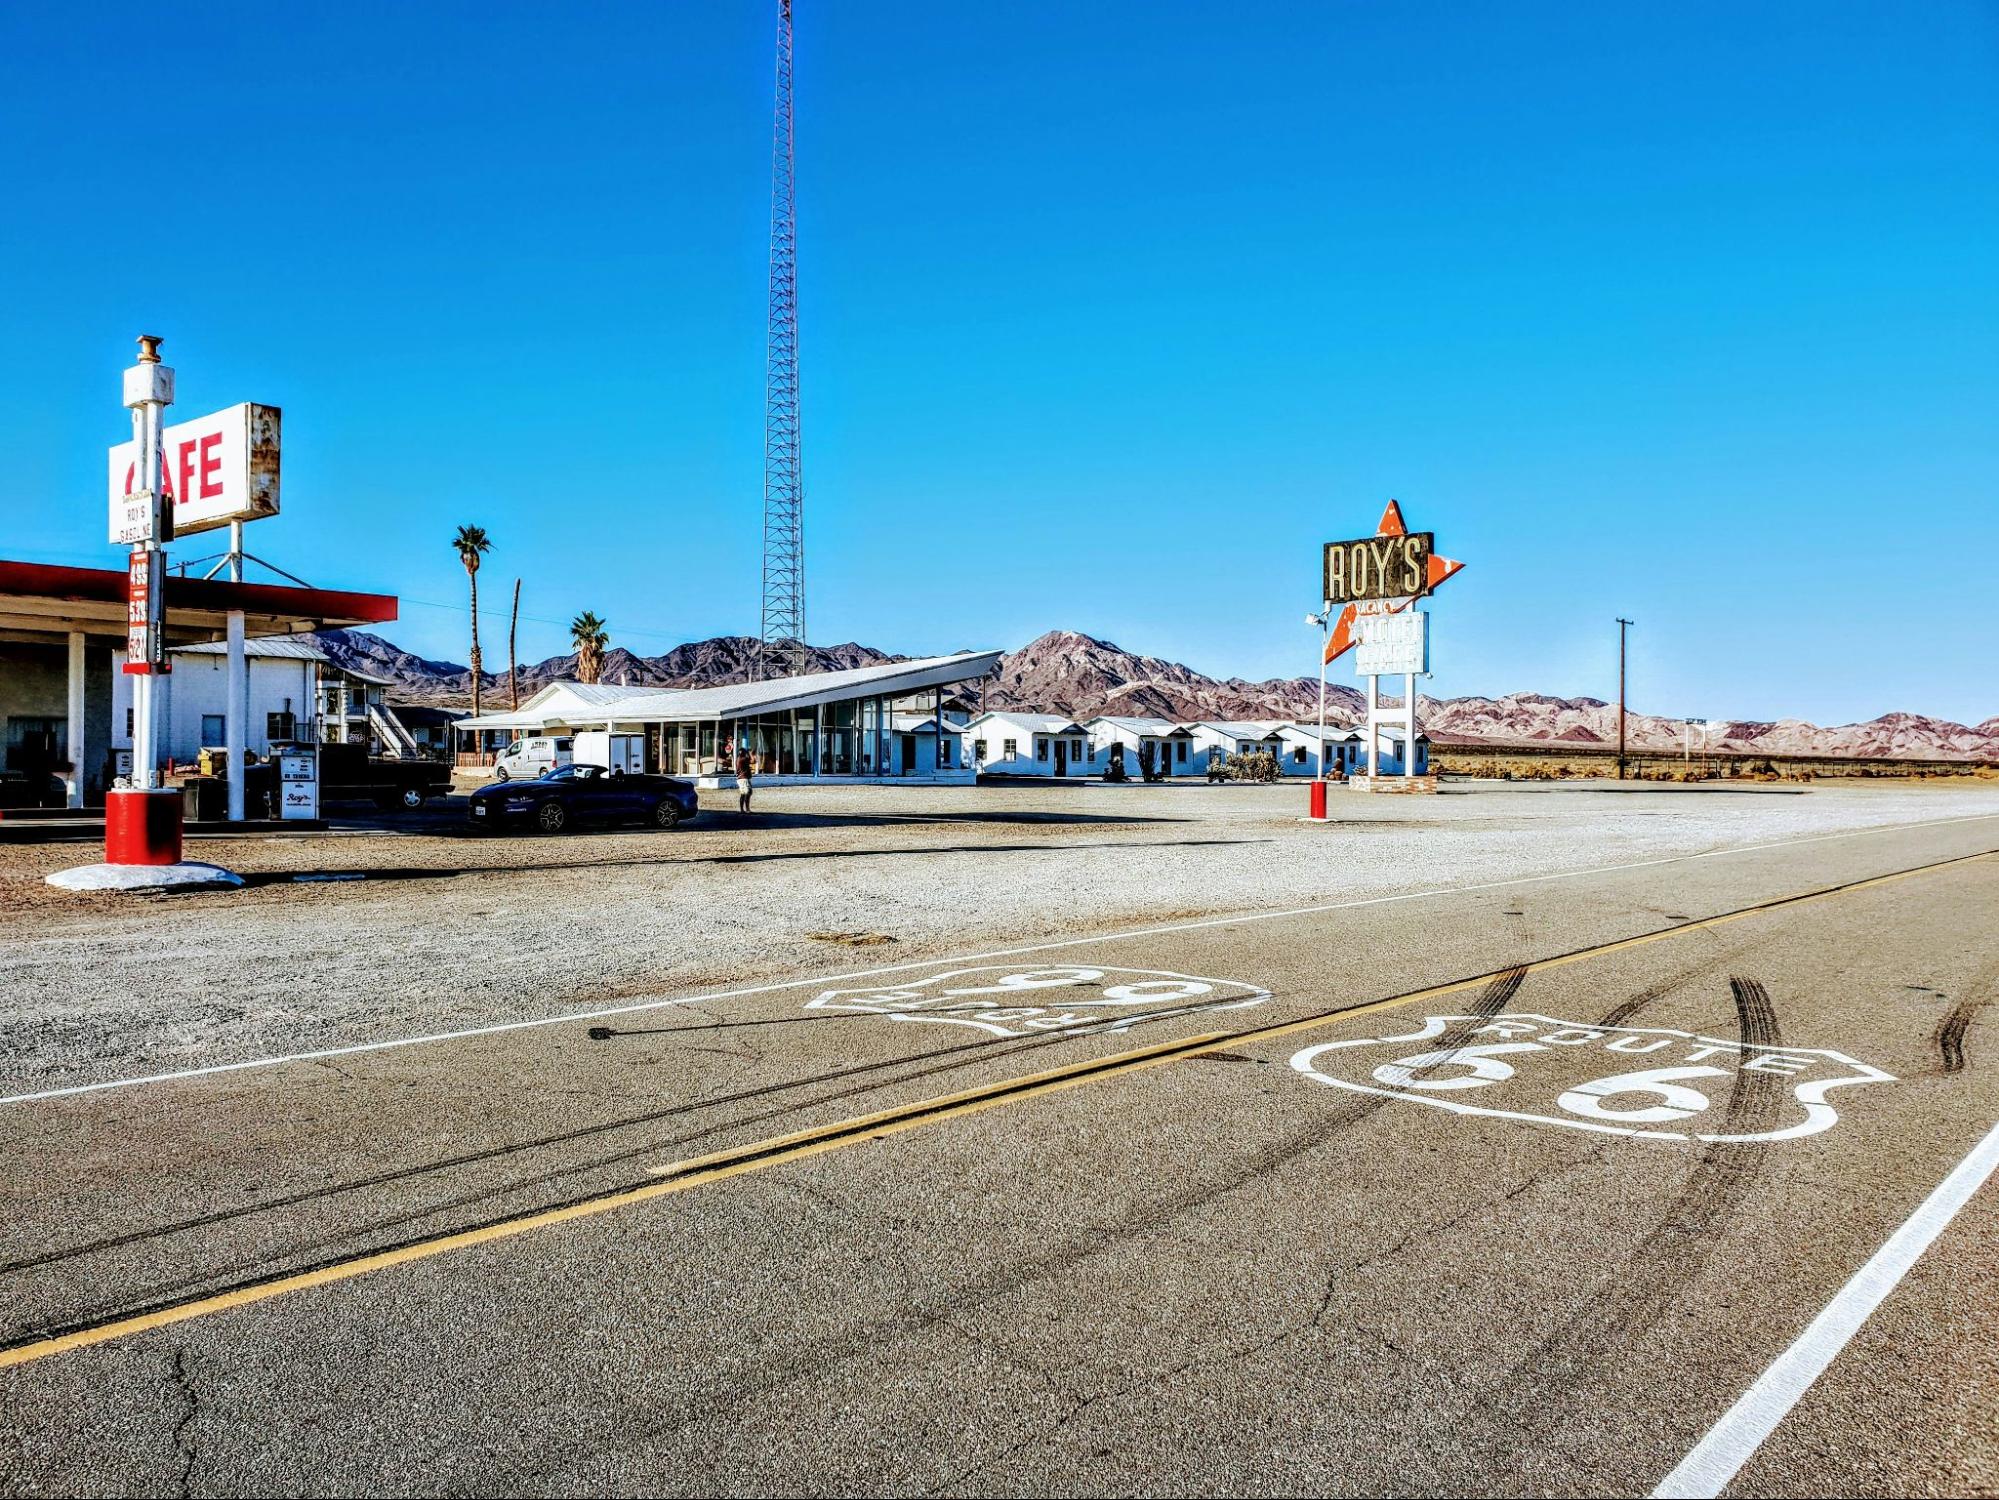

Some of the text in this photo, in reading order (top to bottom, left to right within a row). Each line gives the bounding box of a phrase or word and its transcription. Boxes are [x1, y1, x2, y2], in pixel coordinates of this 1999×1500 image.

[120, 523, 152, 543] GASOLNE
[1329, 537, 1421, 599] ROY'S
[1474, 1023, 1816, 1075] ROUTE
[1373, 1042, 1733, 1121] 66
